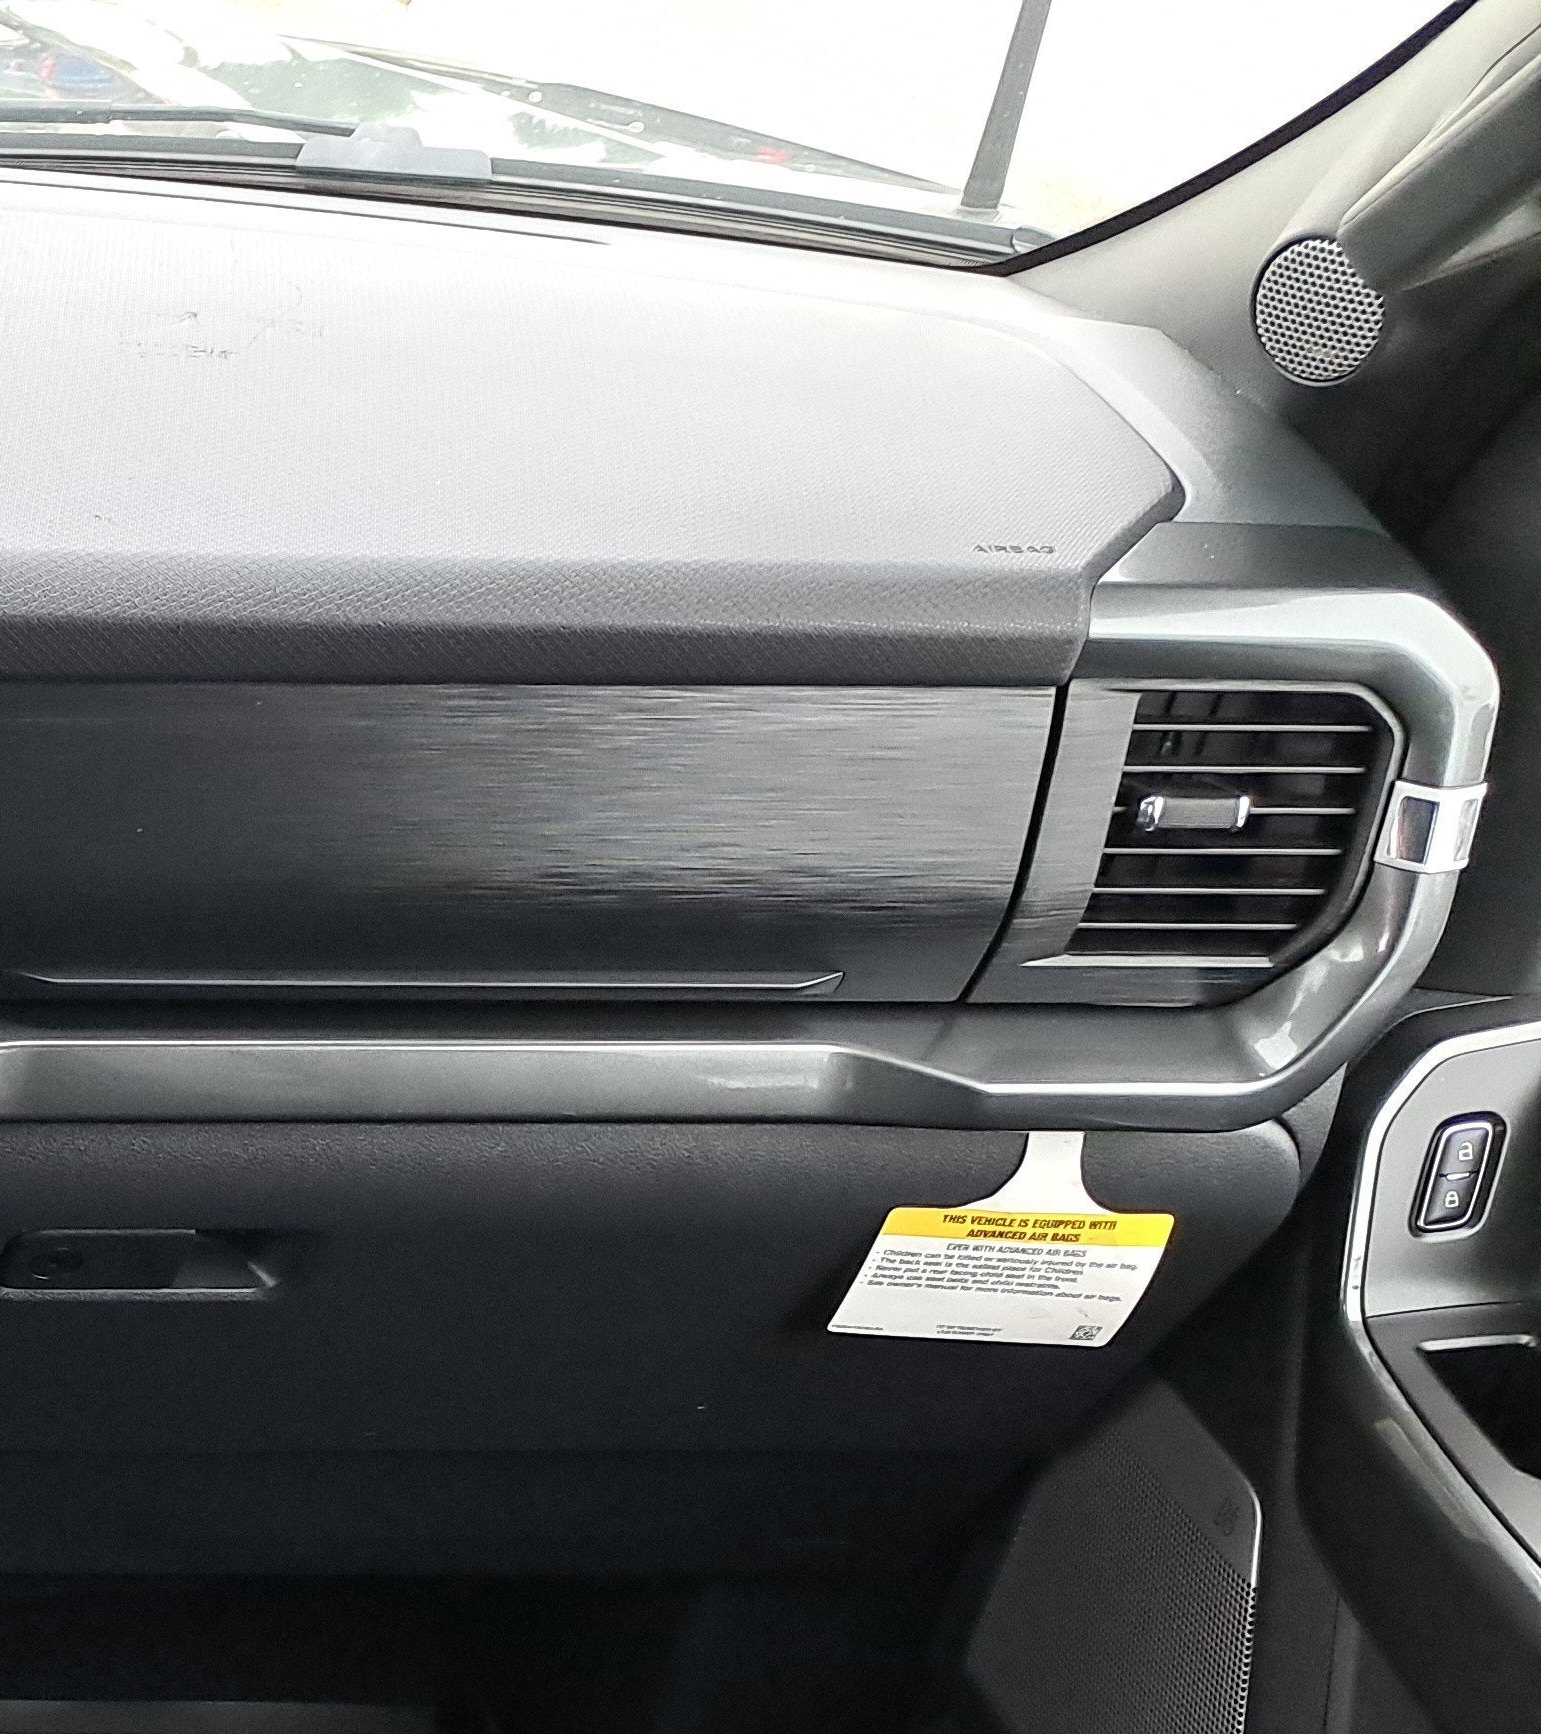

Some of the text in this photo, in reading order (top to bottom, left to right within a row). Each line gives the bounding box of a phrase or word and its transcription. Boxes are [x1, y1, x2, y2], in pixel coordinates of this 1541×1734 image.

[973, 543, 1057, 554] AIRBAG
[942, 1214, 1118, 1231] THIS VEHICLE IS EQUIPPED WITH
[965, 1228, 1082, 1243] ADVANCED AIR BAGS
[996, 1245, 1044, 1256] ADVANCED
[1045, 1248, 1062, 1257] AIR
